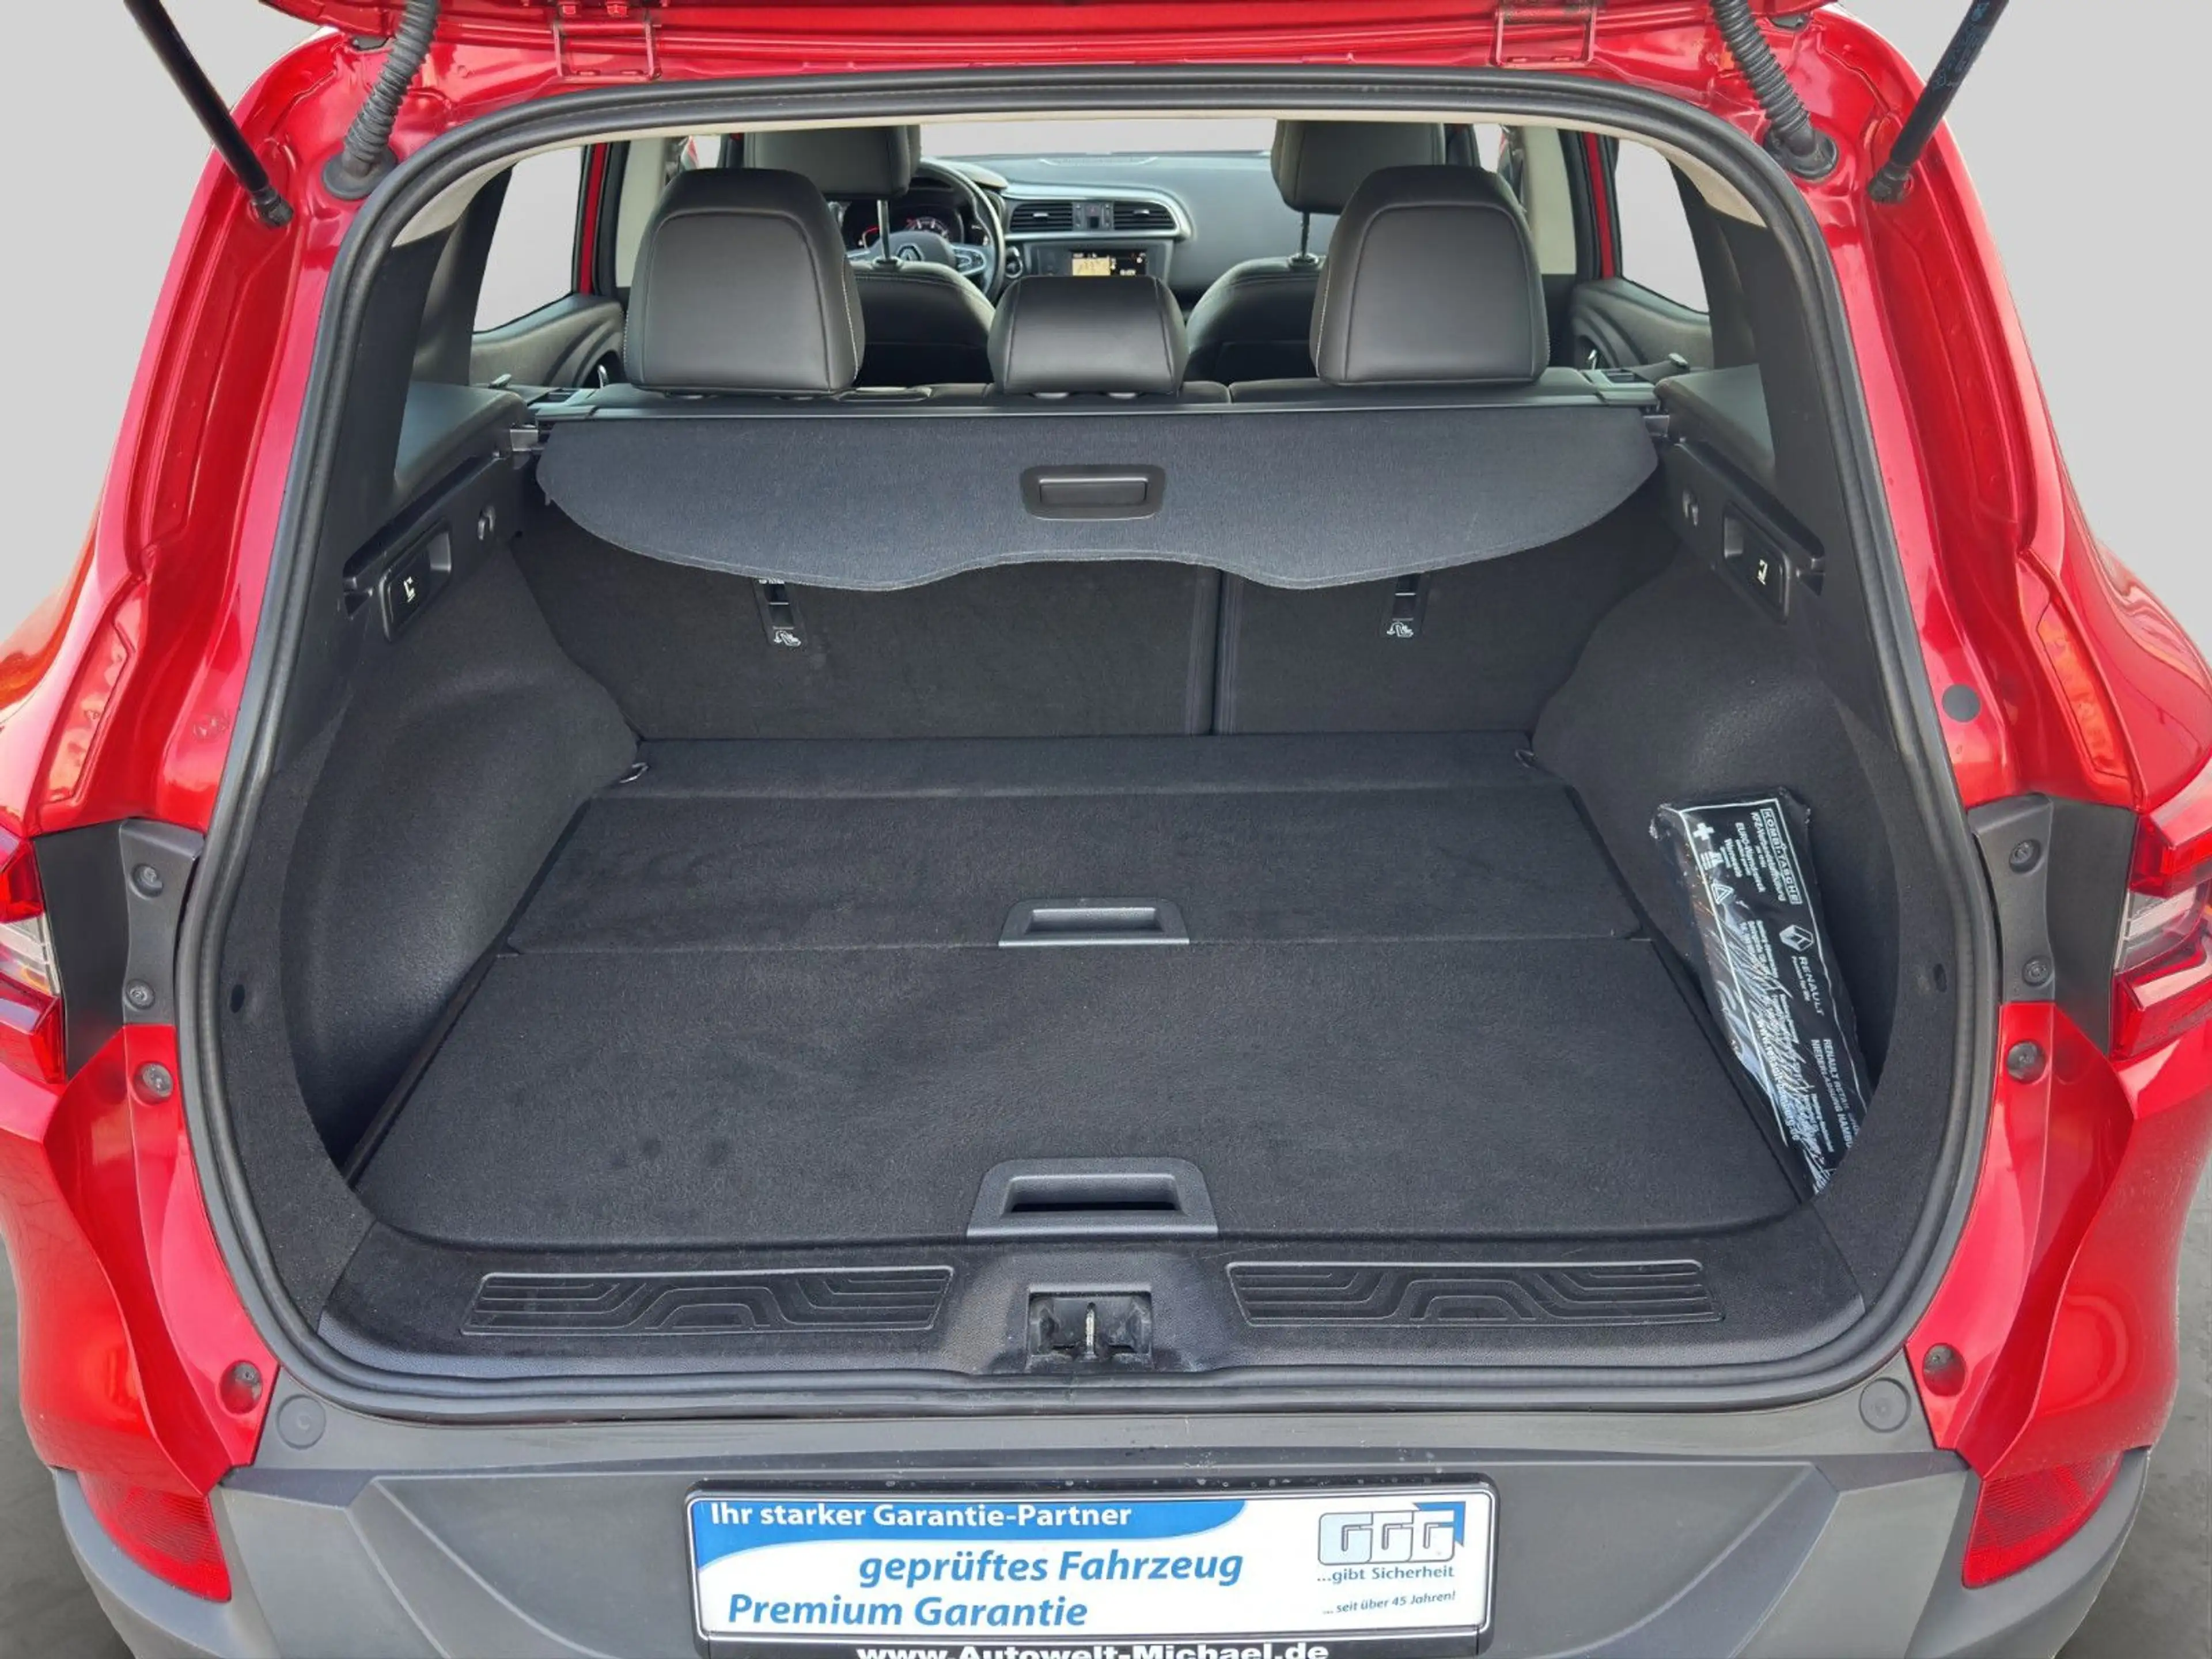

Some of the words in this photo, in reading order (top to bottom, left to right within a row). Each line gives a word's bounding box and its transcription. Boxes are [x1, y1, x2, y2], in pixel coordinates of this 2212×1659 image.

[1798, 956, 1824, 1016] RENAULT
[1823, 1039, 1839, 1078] RENAULT
[711, 1503, 751, 1525] Ihr
[760, 1503, 866, 1526] starker
[873, 1503, 1132, 1527] Garantie-Partner
[859, 1550, 1048, 1588] geprüftes
[1058, 1549, 1244, 1587] Fahrzeug
[1371, 1565, 1455, 1580] Sicherheit
[728, 1594, 903, 1626] Premium
[914, 1596, 1088, 1627] Garantie
[1336, 1601, 1358, 1613] seit
[1360, 1599, 1389, 1611] über
[1392, 1595, 1407, 1606] 45
[1411, 1589, 1456, 1605] Jahren!
